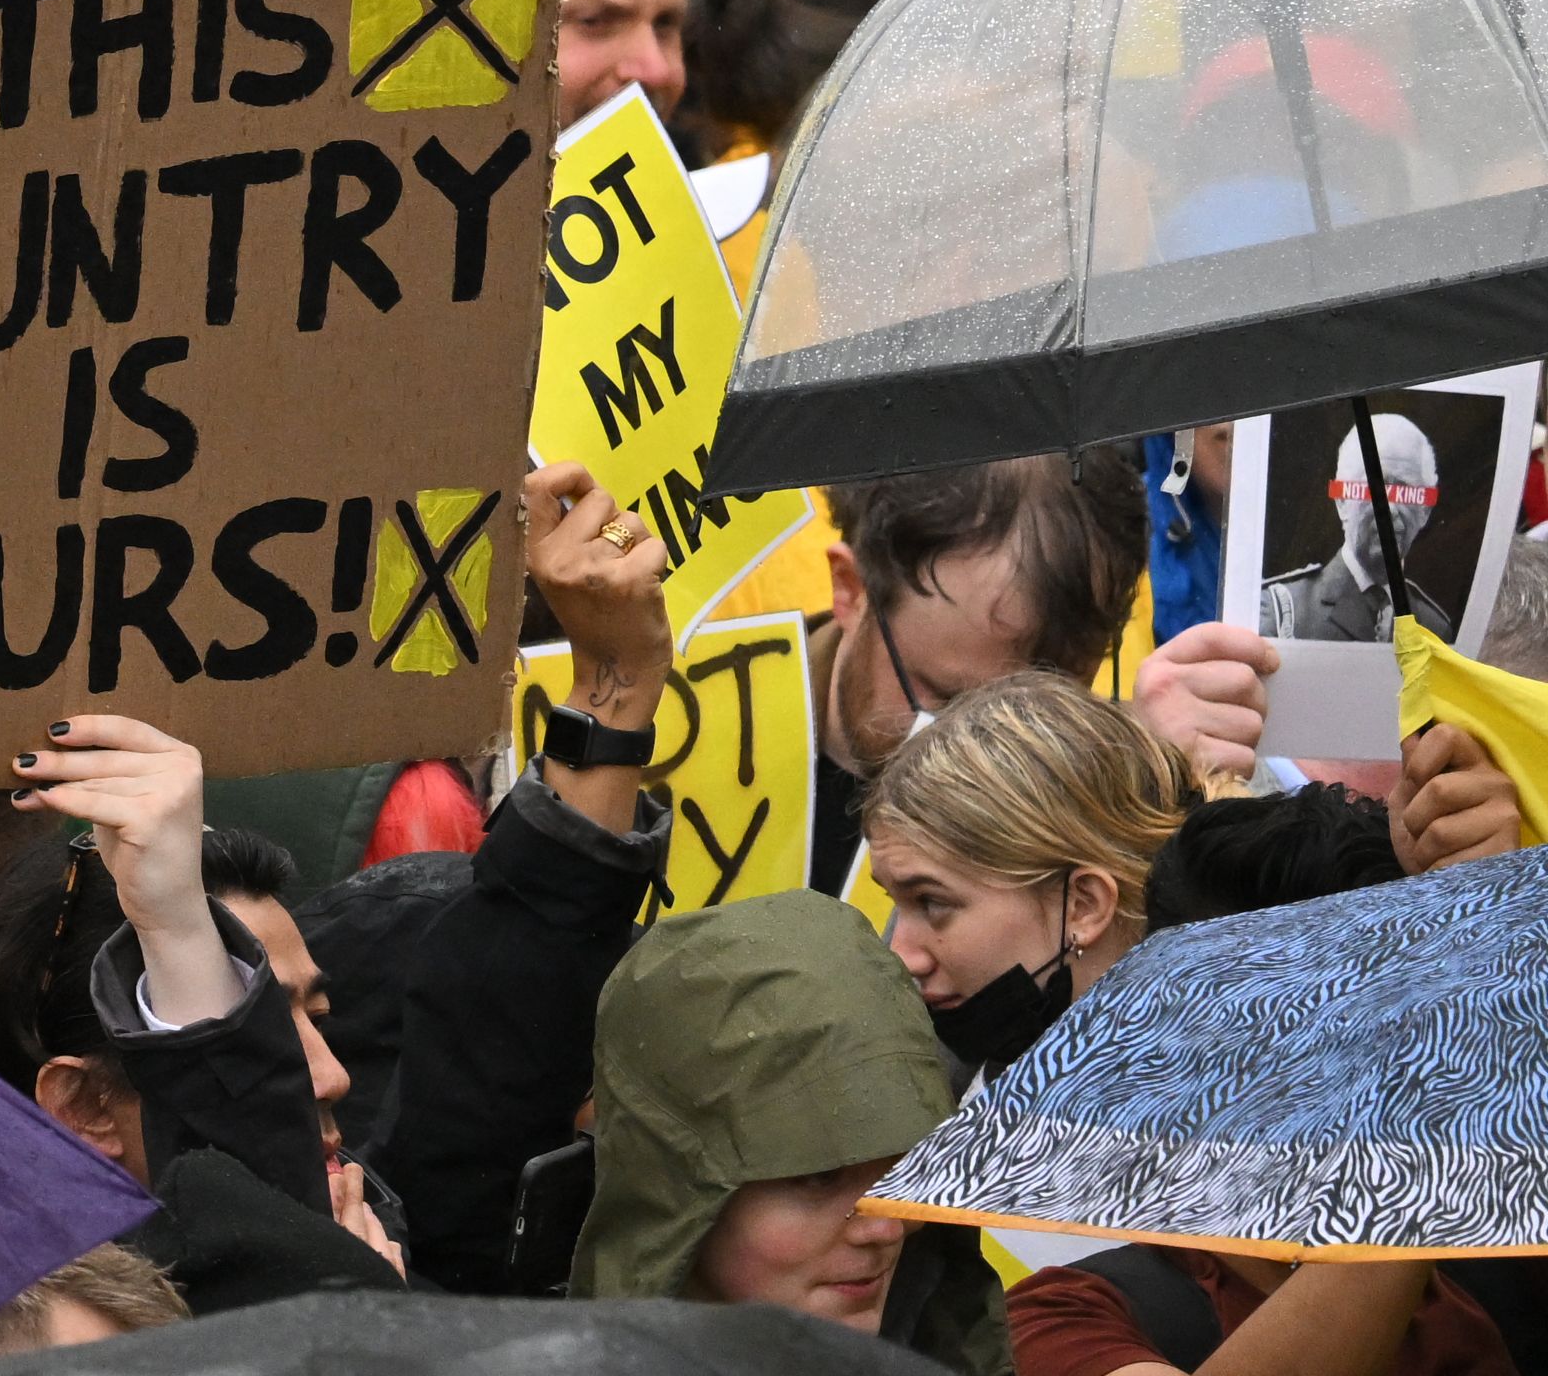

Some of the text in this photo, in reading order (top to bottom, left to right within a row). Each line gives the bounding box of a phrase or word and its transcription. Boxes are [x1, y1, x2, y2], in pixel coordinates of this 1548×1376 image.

[57, 334, 200, 501] IS
[578, 295, 690, 452] MY
[1341, 481, 1368, 500] NOT
[1395, 486, 1426, 505] KING
